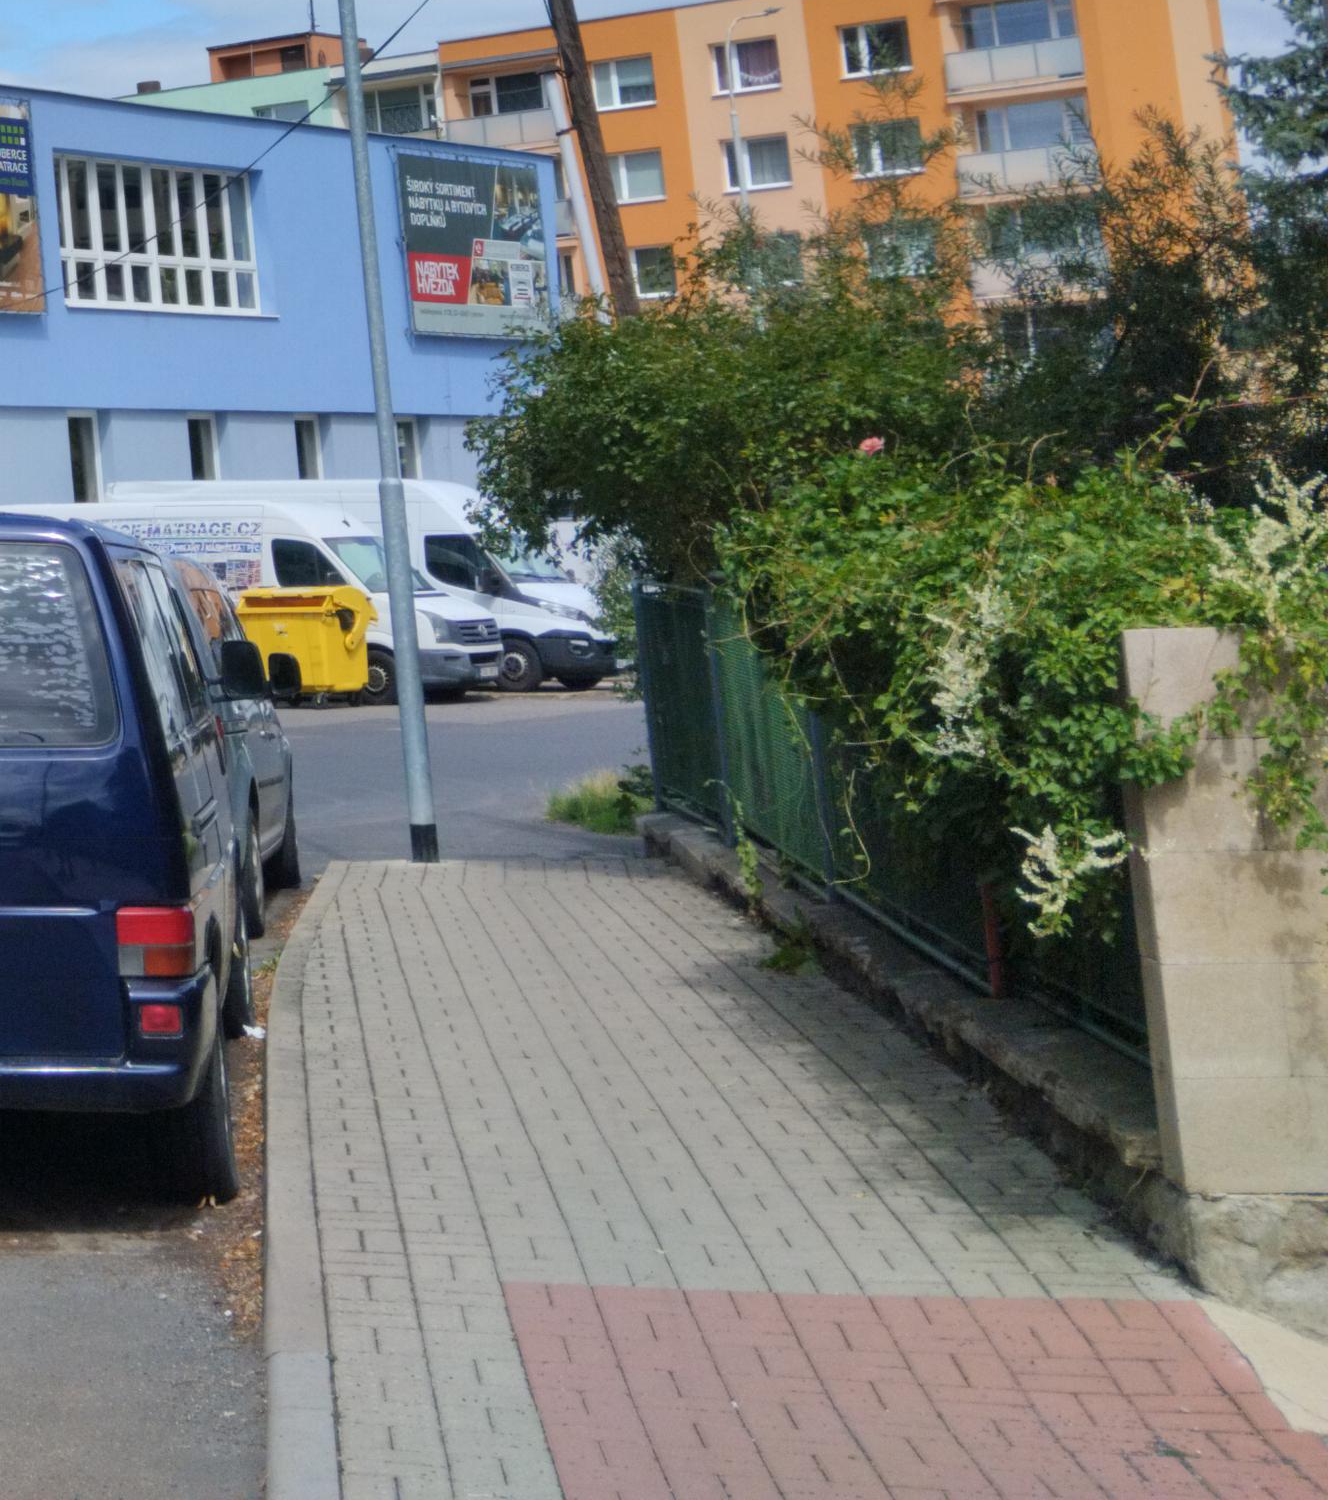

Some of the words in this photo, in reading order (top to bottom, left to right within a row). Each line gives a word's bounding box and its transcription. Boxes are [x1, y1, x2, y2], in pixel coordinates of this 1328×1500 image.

[406, 175, 433, 194] ŠIROKÝ
[435, 182, 475, 198] SORTIMENT
[408, 193, 444, 211] NÁBYTKU
[445, 200, 450, 212] A
[451, 200, 487, 215] BYTOVÝCH
[112, 522, 262, 539] CE-MATRACE.CZ
